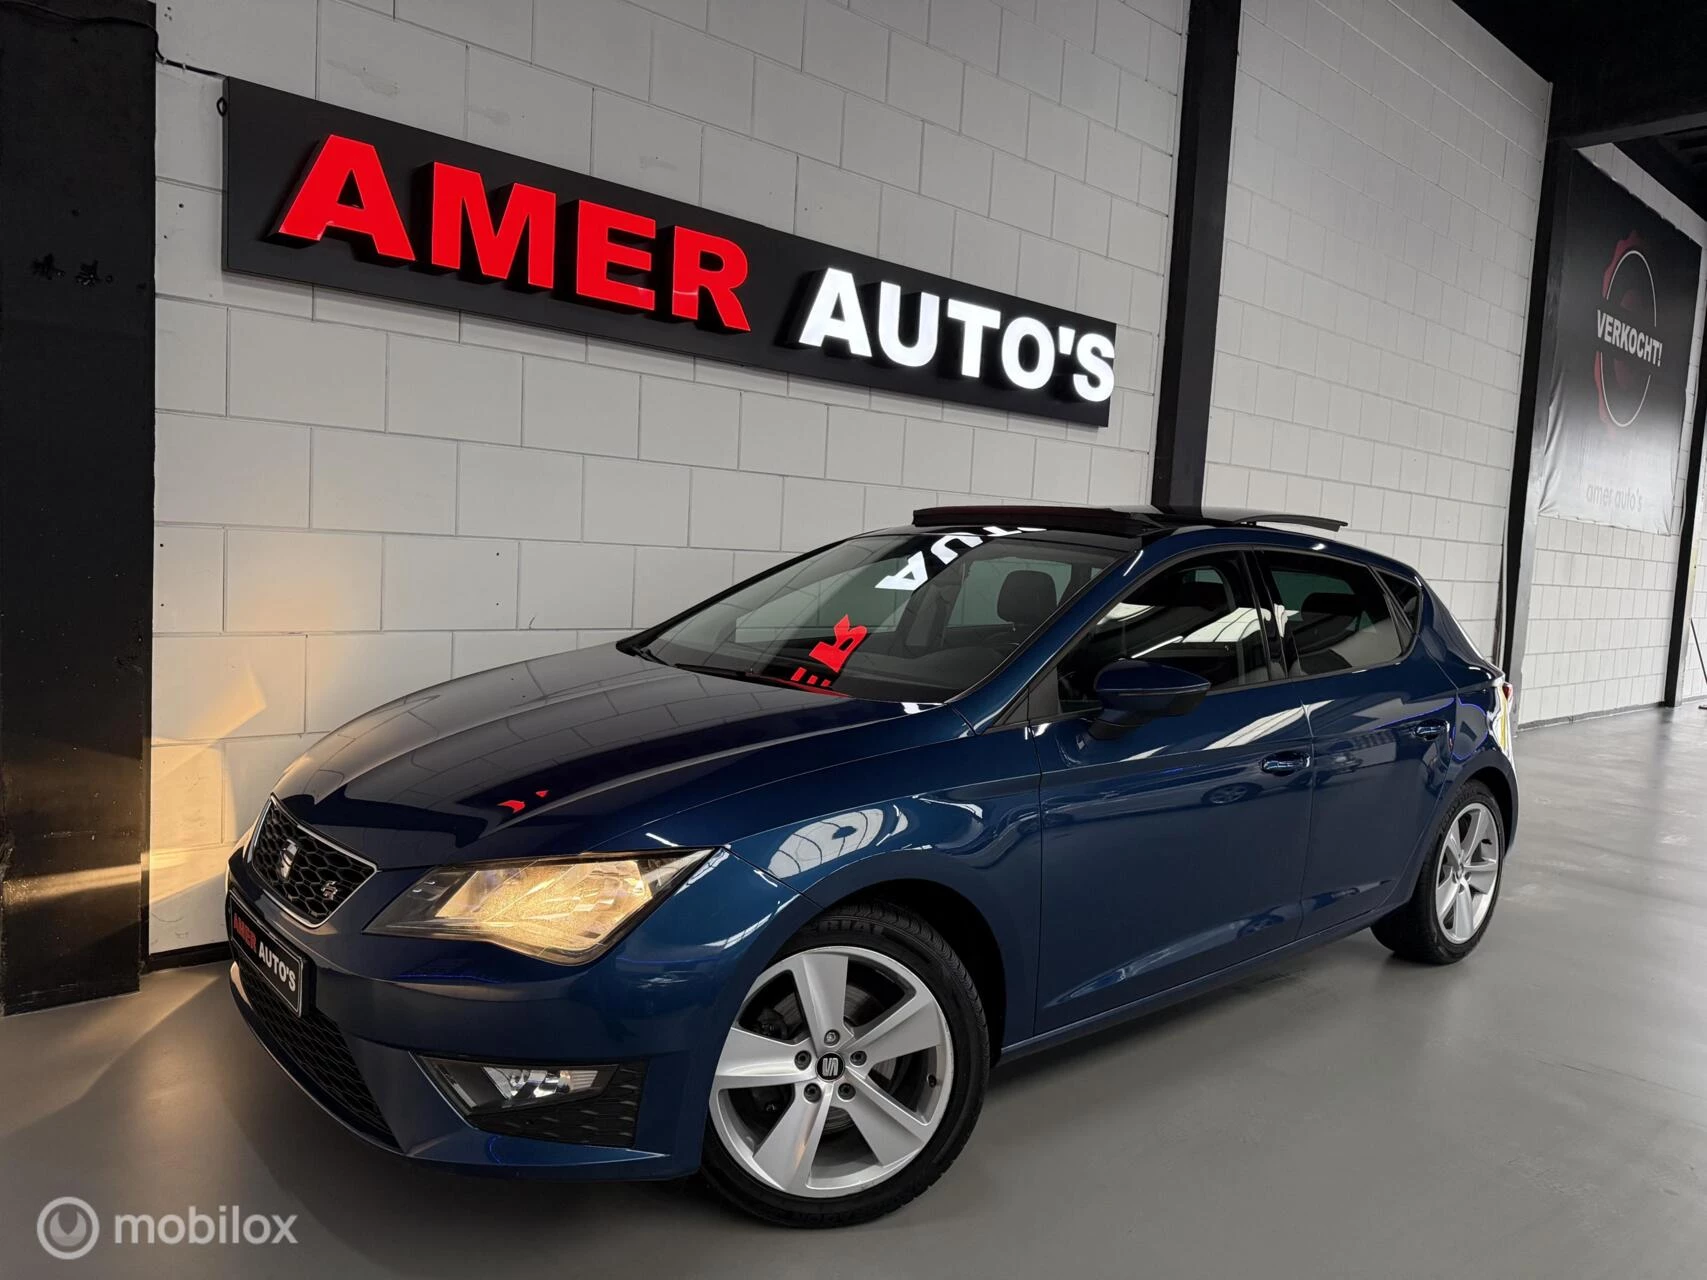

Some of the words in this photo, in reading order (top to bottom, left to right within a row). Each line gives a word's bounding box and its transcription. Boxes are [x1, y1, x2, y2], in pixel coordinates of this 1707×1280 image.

[277, 134, 751, 332] AMER
[798, 267, 1116, 403] AUTO'S
[1596, 309, 1663, 368] VERKOCHT!
[1585, 483, 1614, 508] amer
[258, 941, 296, 992] AUTO'S
